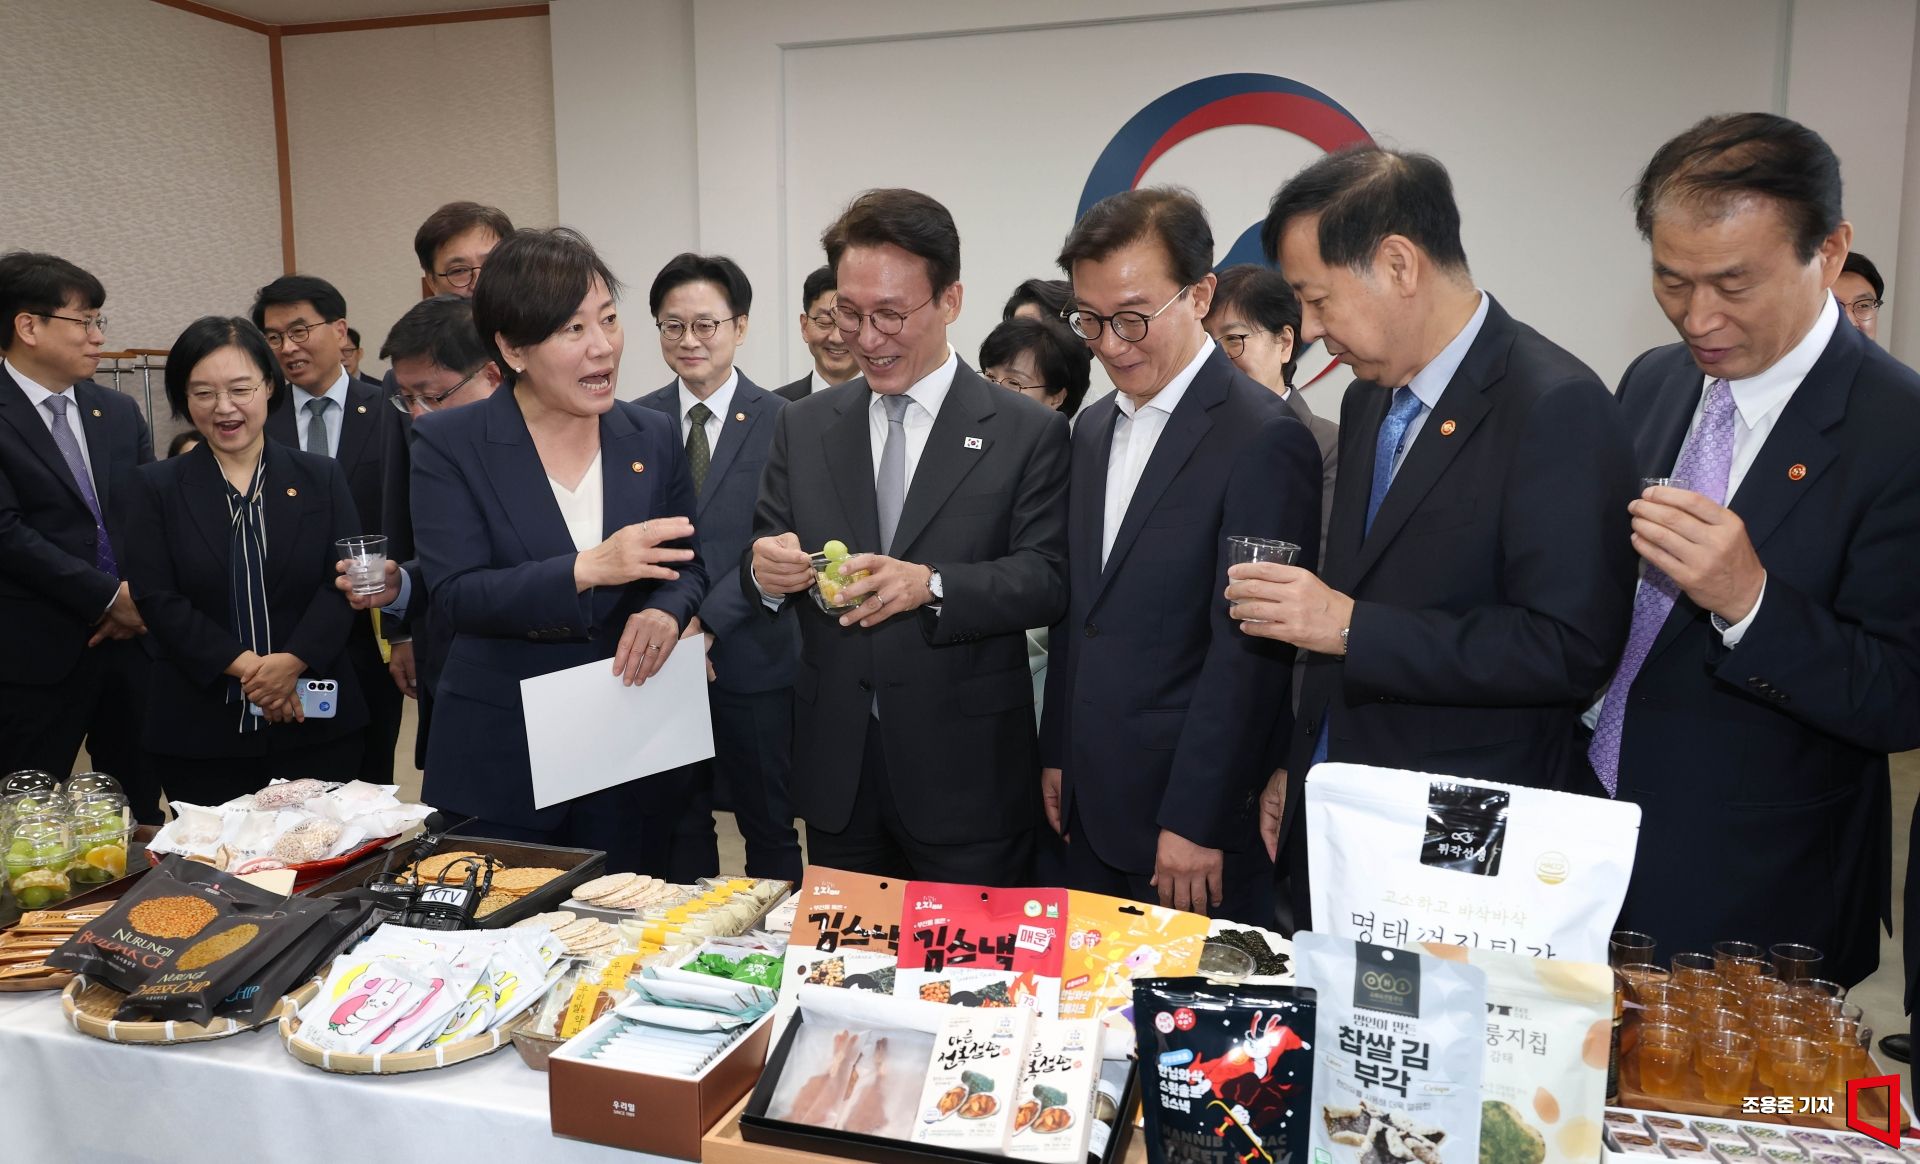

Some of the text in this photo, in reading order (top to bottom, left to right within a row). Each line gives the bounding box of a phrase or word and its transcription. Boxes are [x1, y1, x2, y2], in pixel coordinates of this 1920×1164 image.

[429, 889, 461, 903] KTV
[1381, 890, 1527, 930] 고소하고 바삭바삭
[913, 925, 1018, 973] 김스낵
[1020, 929, 1048, 947] 매운
[949, 1029, 973, 1047] 마른
[1338, 1025, 1430, 1071] 찹쌀 김
[1486, 1023, 1548, 1056] 룽지칩
[1023, 1054, 1072, 1082] 복절편
[1354, 1060, 1411, 1098] 부각
[612, 1100, 635, 1112] 우리밀
